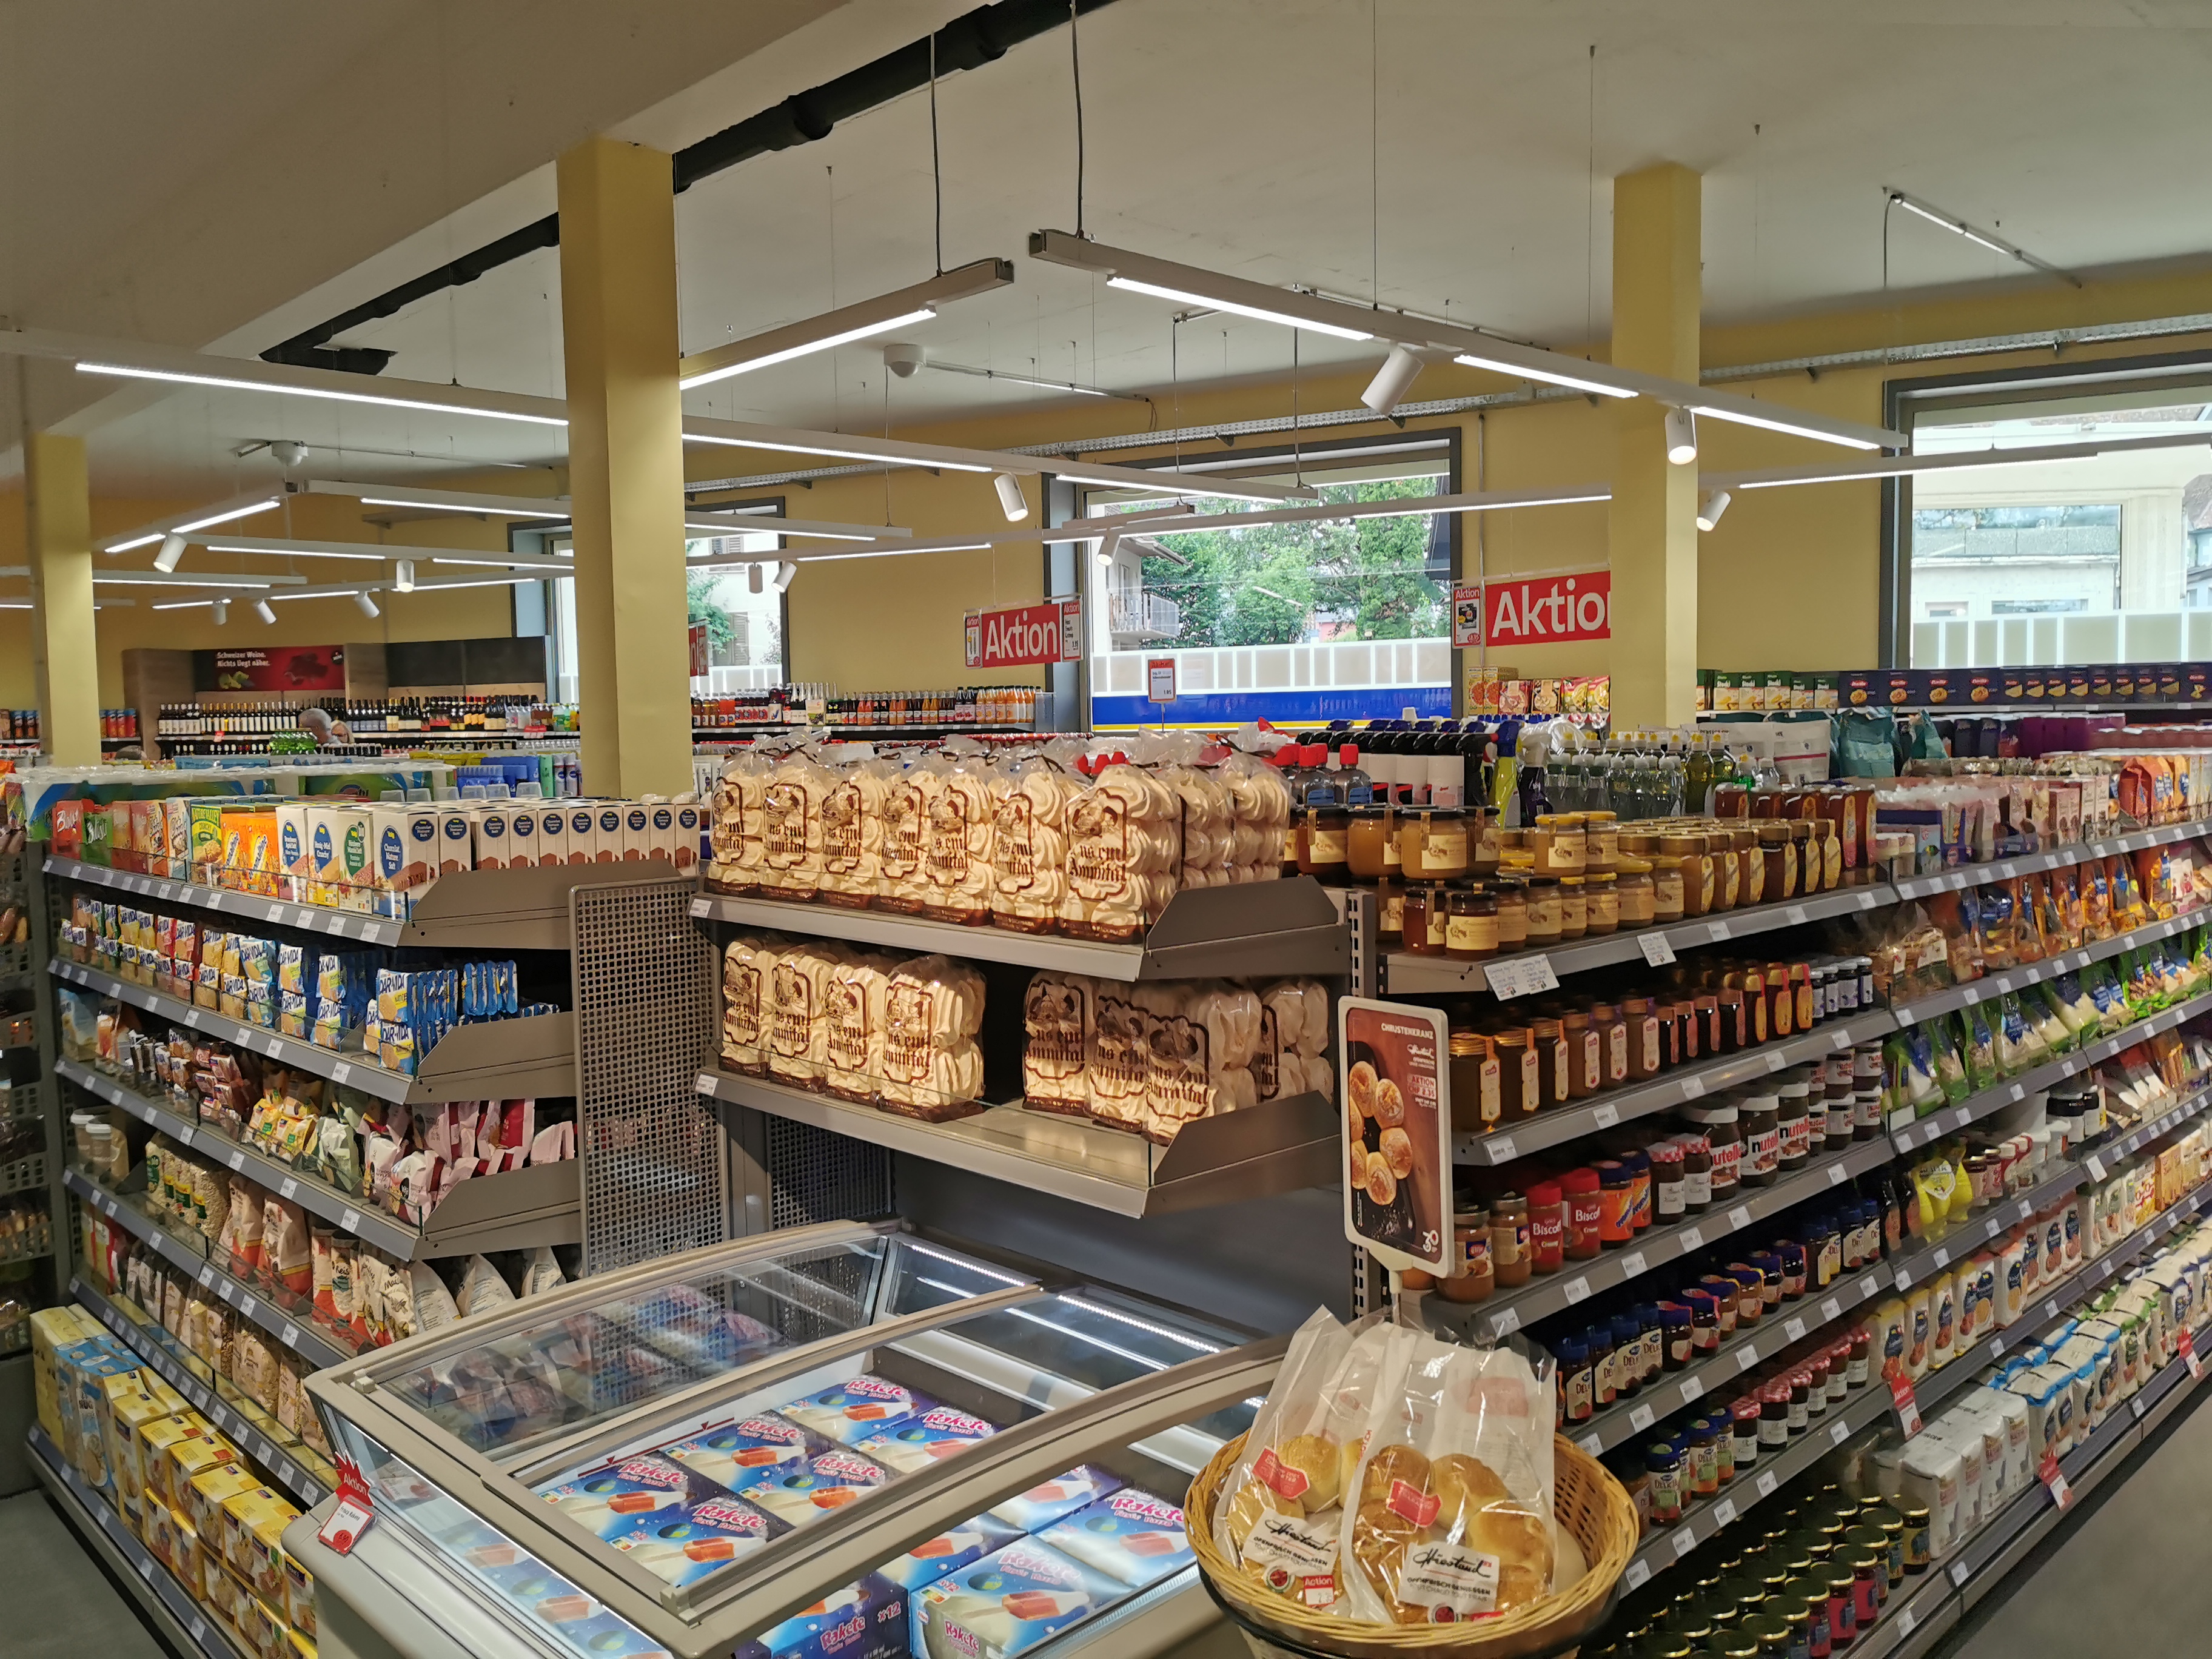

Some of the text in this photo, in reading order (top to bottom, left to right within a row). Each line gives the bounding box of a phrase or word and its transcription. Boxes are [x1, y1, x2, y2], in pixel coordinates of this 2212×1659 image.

[1456, 588, 1480, 599] Aktion
[1064, 602, 1080, 614] Aktion
[1491, 578, 1611, 638] Aktio
[985, 610, 1057, 660] Aktion
[384, 843, 401, 853] Chocolat
[379, 973, 406, 994] DAR-VIDA
[382, 1025, 409, 1041] DAR-VIDA
[1412, 1075, 1435, 1087] AKTION
[336, 1265, 350, 1275] Reis
[843, 1379, 910, 1396] Rakete
[737, 1419, 805, 1439] Rakete
[923, 1412, 992, 1432] Rakete
[617, 1461, 689, 1485] Rakete
[813, 1456, 885, 1479] Rakete
[344, 1472, 367, 1496] Aktion
[692, 1503, 767, 1529] Rakete
[997, 1550, 1082, 1581] Rakete
[1412, 1547, 1492, 1578] Hiestand
[937, 1580, 960, 1593] x12
[1304, 1577, 1333, 1586] Action
[877, 1601, 902, 1623] x12
[820, 1615, 866, 1651] Rakete
[943, 1618, 981, 1654] Rakete
